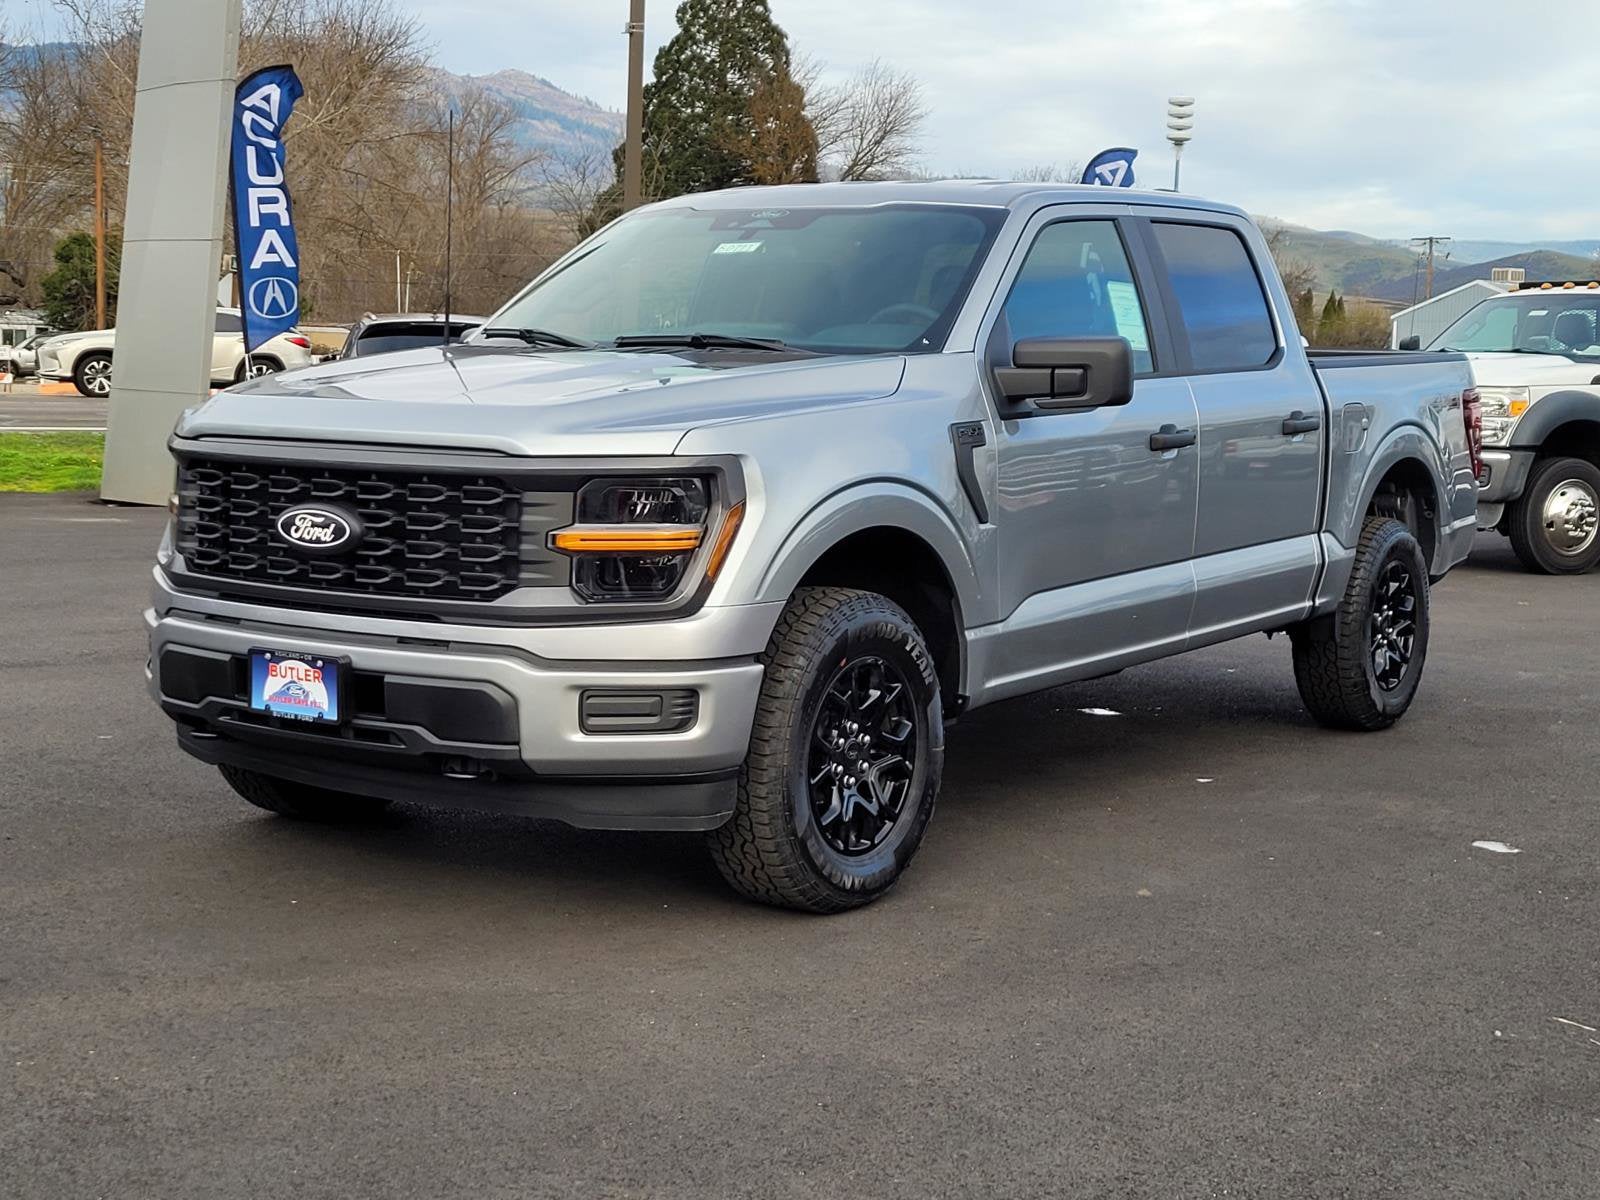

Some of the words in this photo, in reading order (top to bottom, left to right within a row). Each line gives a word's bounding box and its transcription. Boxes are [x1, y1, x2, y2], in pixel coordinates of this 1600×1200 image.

[240, 83, 297, 269] ACURA
[290, 513, 336, 542] Ford
[270, 664, 321, 683] BUTLER
